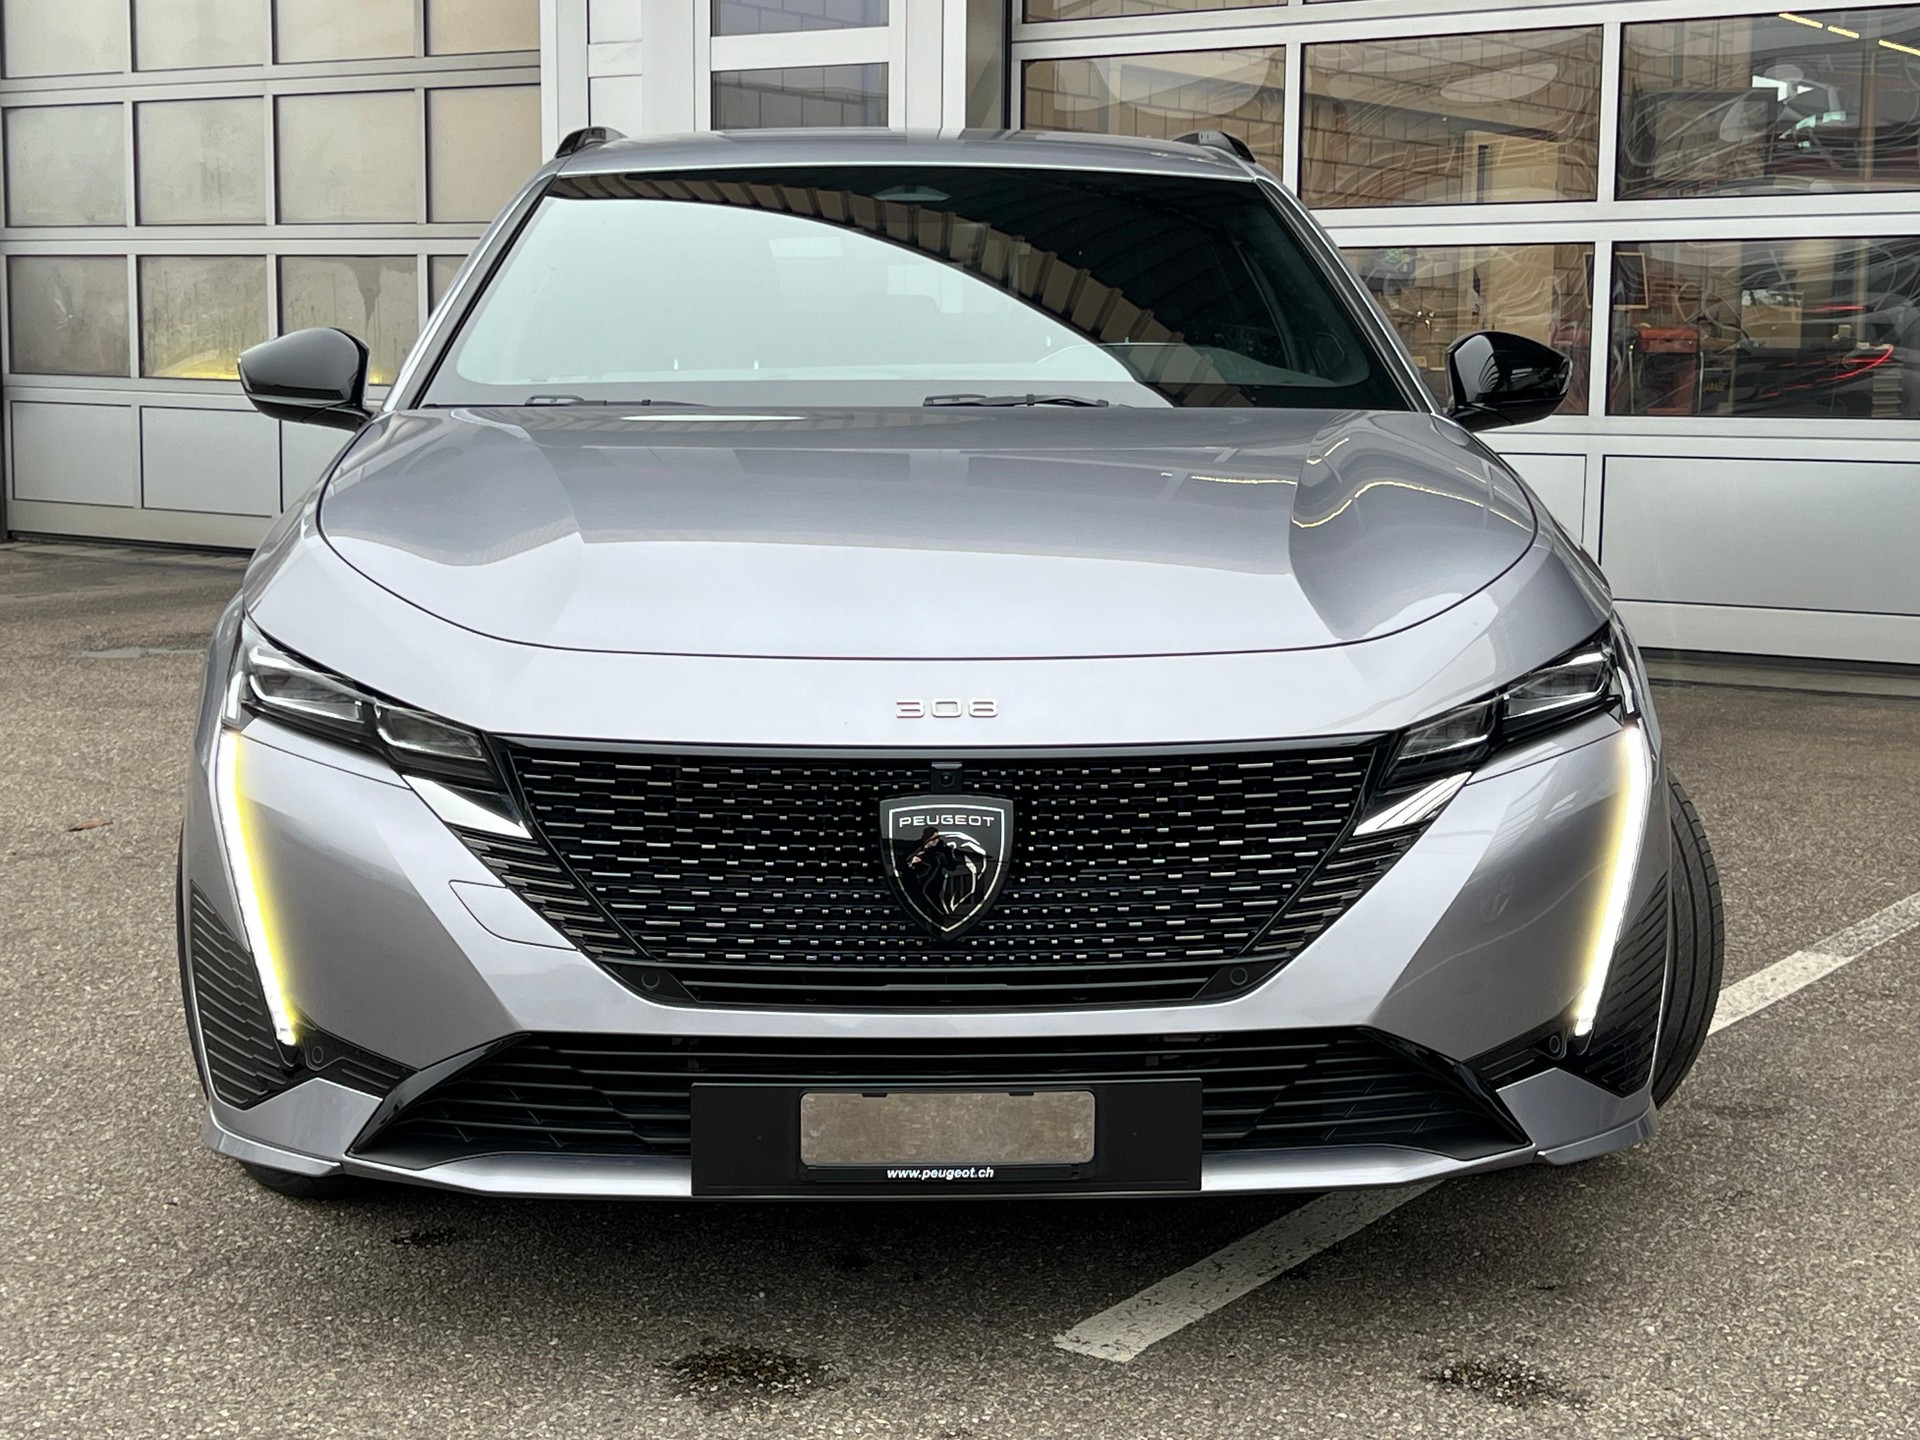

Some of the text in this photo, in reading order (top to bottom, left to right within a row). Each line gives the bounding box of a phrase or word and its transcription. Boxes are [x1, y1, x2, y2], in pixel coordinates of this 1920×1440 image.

[896, 698, 998, 719] 308
[899, 814, 995, 828] PEUGEOT
[886, 1166, 994, 1180] www.peugeot.ch
